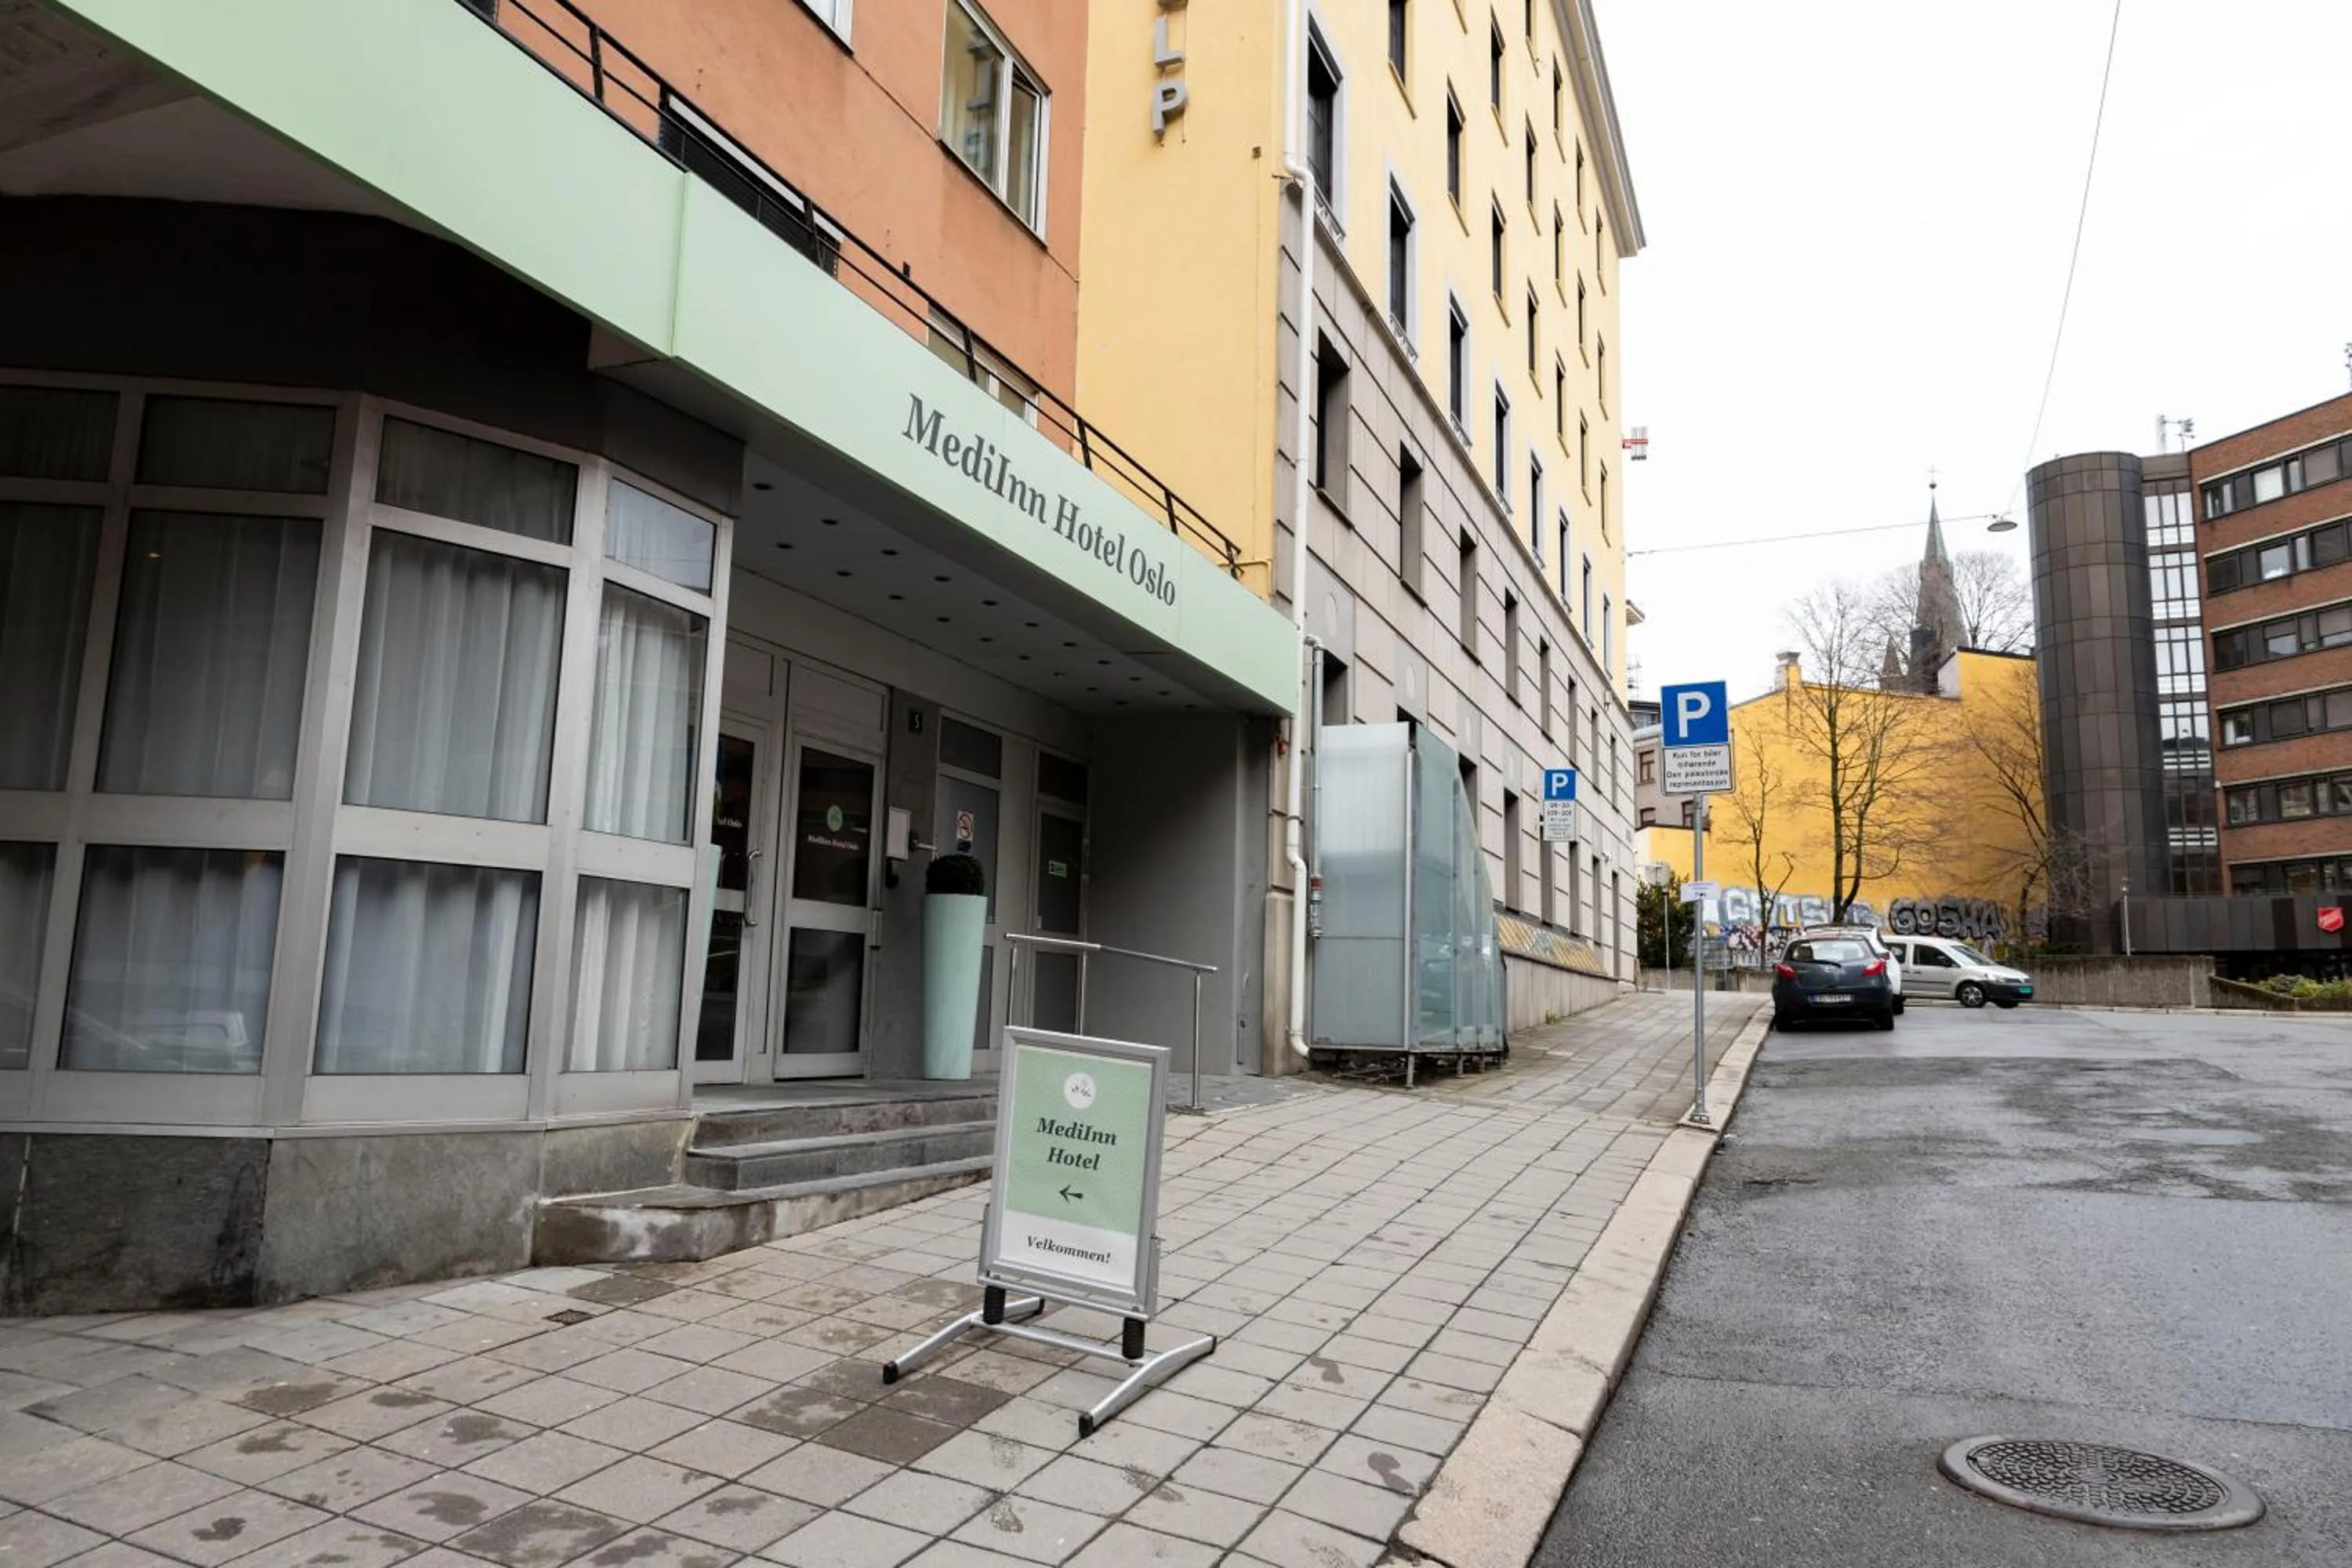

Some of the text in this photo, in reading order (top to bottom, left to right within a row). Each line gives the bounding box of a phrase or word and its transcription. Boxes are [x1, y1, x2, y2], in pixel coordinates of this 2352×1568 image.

[1153, 0, 1187, 132] LP
[902, 392, 1176, 607] MediInn Hotel Oslo
[1677, 691, 1711, 738] P
[1552, 773, 1569, 797] P
[1036, 1117, 1117, 1146] MediInn
[1046, 1147, 1101, 1171] Hotel
[1027, 1235, 1112, 1264] Velkommen!
